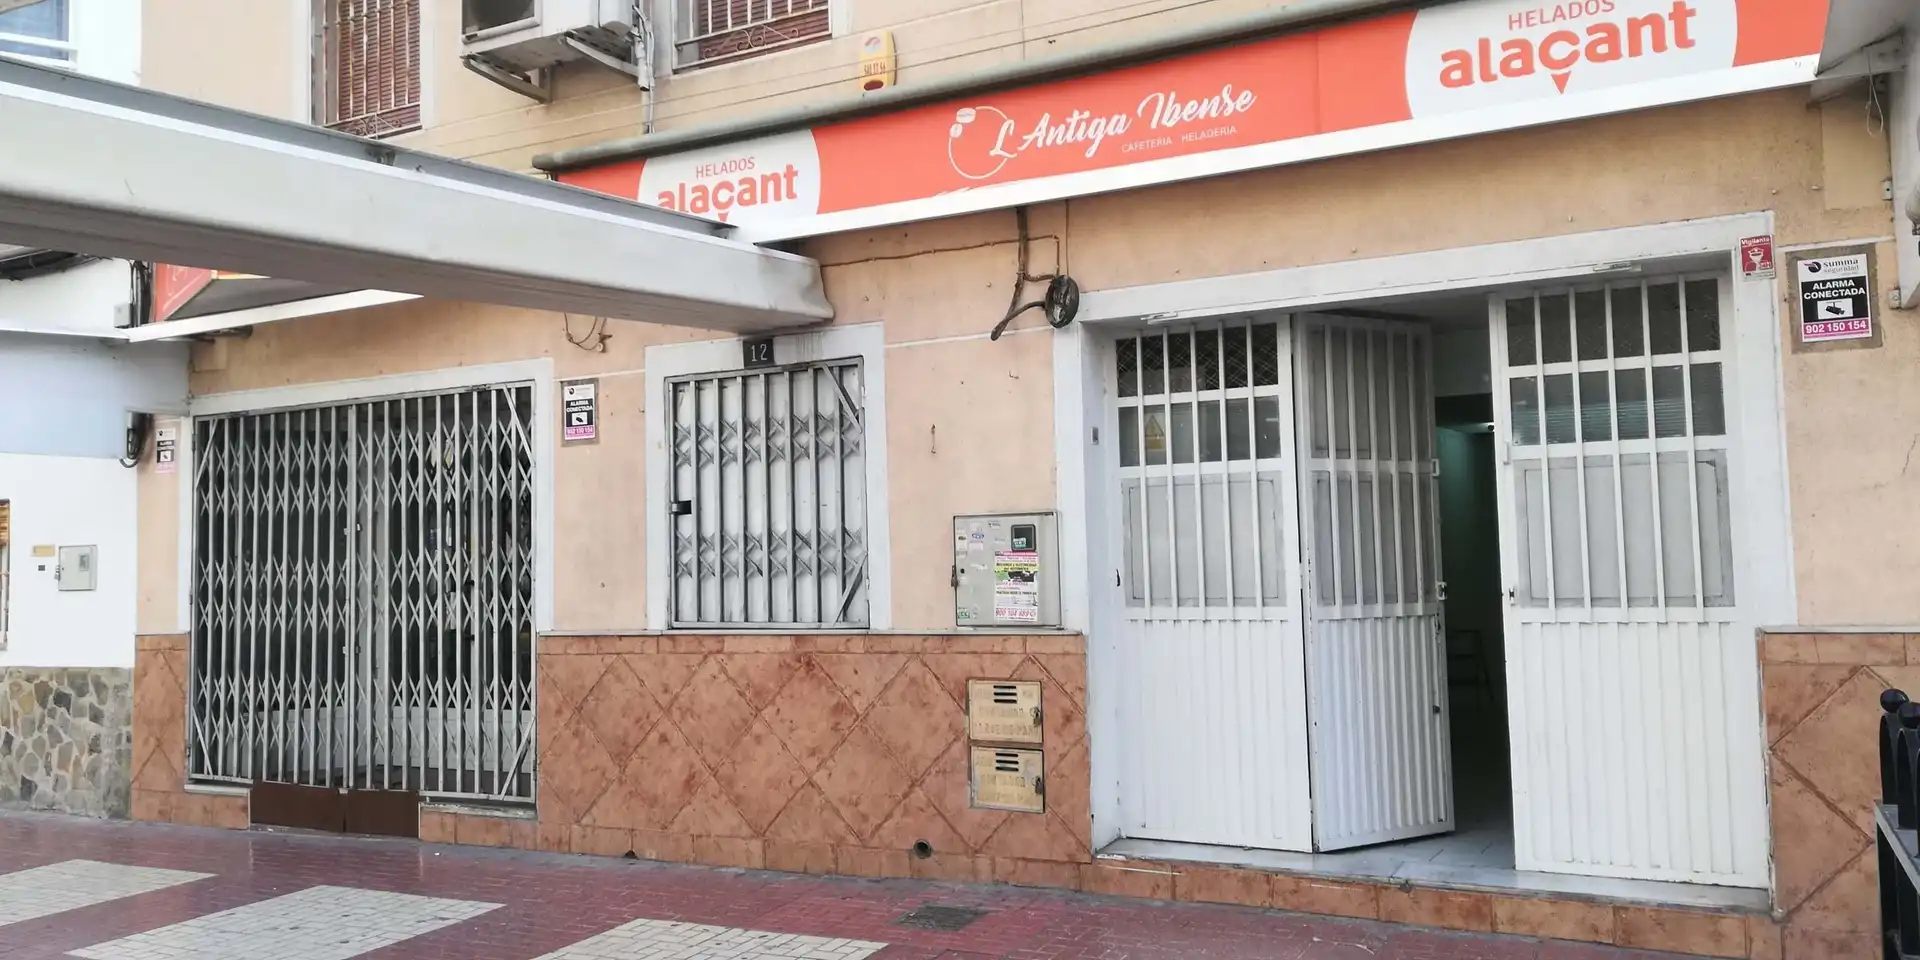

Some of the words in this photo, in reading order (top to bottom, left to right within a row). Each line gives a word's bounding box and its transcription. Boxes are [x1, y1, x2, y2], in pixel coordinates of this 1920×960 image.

[1508, 0, 1615, 31] HELADOS
[1439, 1, 1697, 94] alaçant
[1017, 109, 1133, 158] Antiga
[1137, 83, 1257, 129] Ibense
[1121, 137, 1173, 153] CAFETERIA
[1181, 126, 1237, 143] HELADERIA
[696, 156, 756, 180] HELADOS
[1823, 259, 1859, 268] summa
[1823, 265, 1860, 274] seguridad
[1813, 279, 1855, 290] ALARMA
[1804, 287, 1866, 300] CONECTADA
[1805, 324, 1825, 334] 902
[1827, 322, 1845, 332] 150
[1848, 320, 1867, 330] 154
[751, 343, 768, 361] 12
[566, 405, 593, 413] CONECTADA
